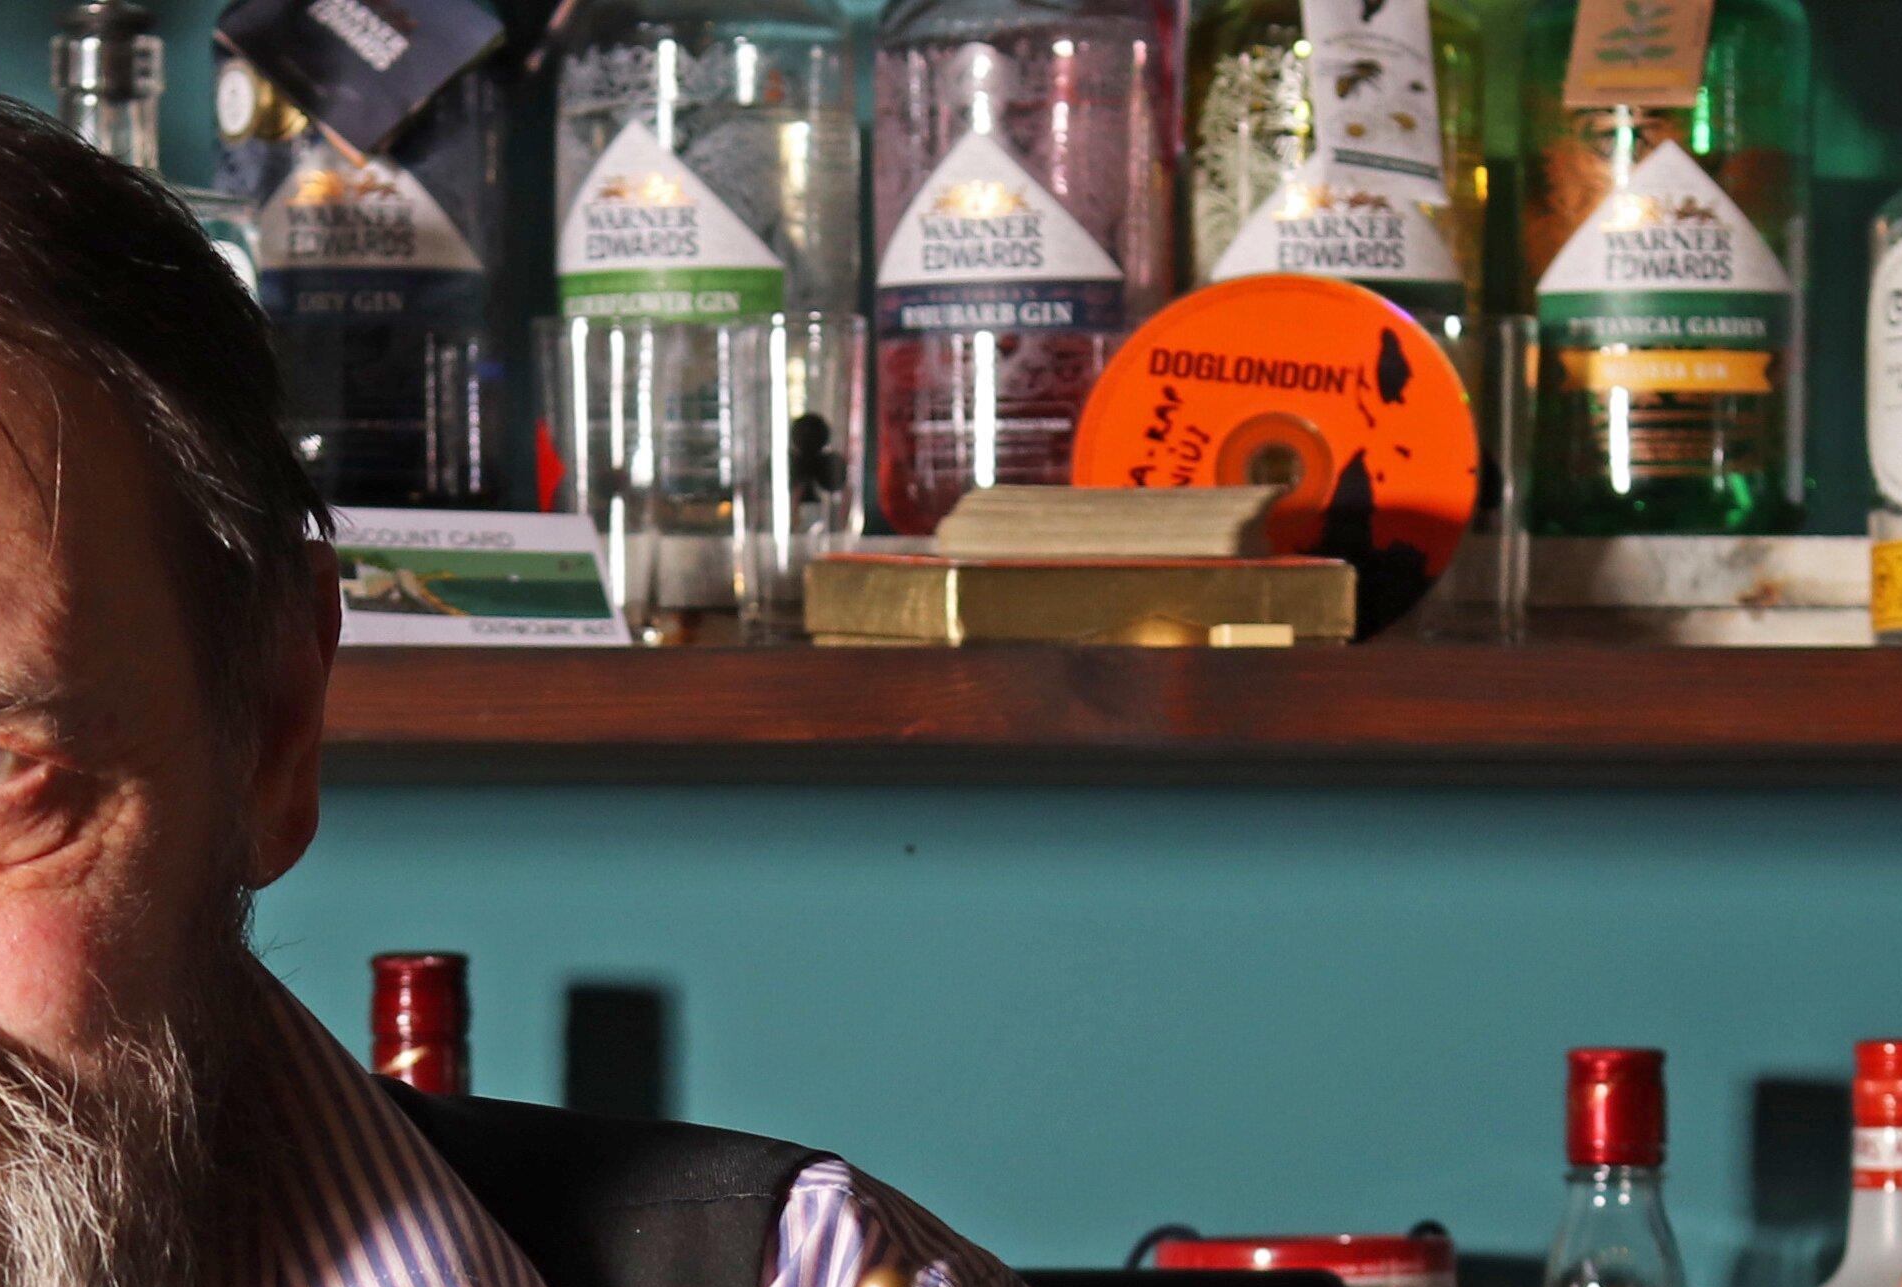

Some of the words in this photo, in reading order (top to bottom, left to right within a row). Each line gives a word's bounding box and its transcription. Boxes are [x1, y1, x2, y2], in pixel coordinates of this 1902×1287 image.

[920, 212, 1043, 241] WARNER
[1277, 212, 1406, 240] WARNER
[1603, 229, 1734, 251] WARNER
[923, 240, 1045, 272] EDWARDS
[1279, 240, 1407, 270] EDWARDS
[1605, 253, 1734, 282] EDWARDS
[1019, 301, 1074, 326] GIN
